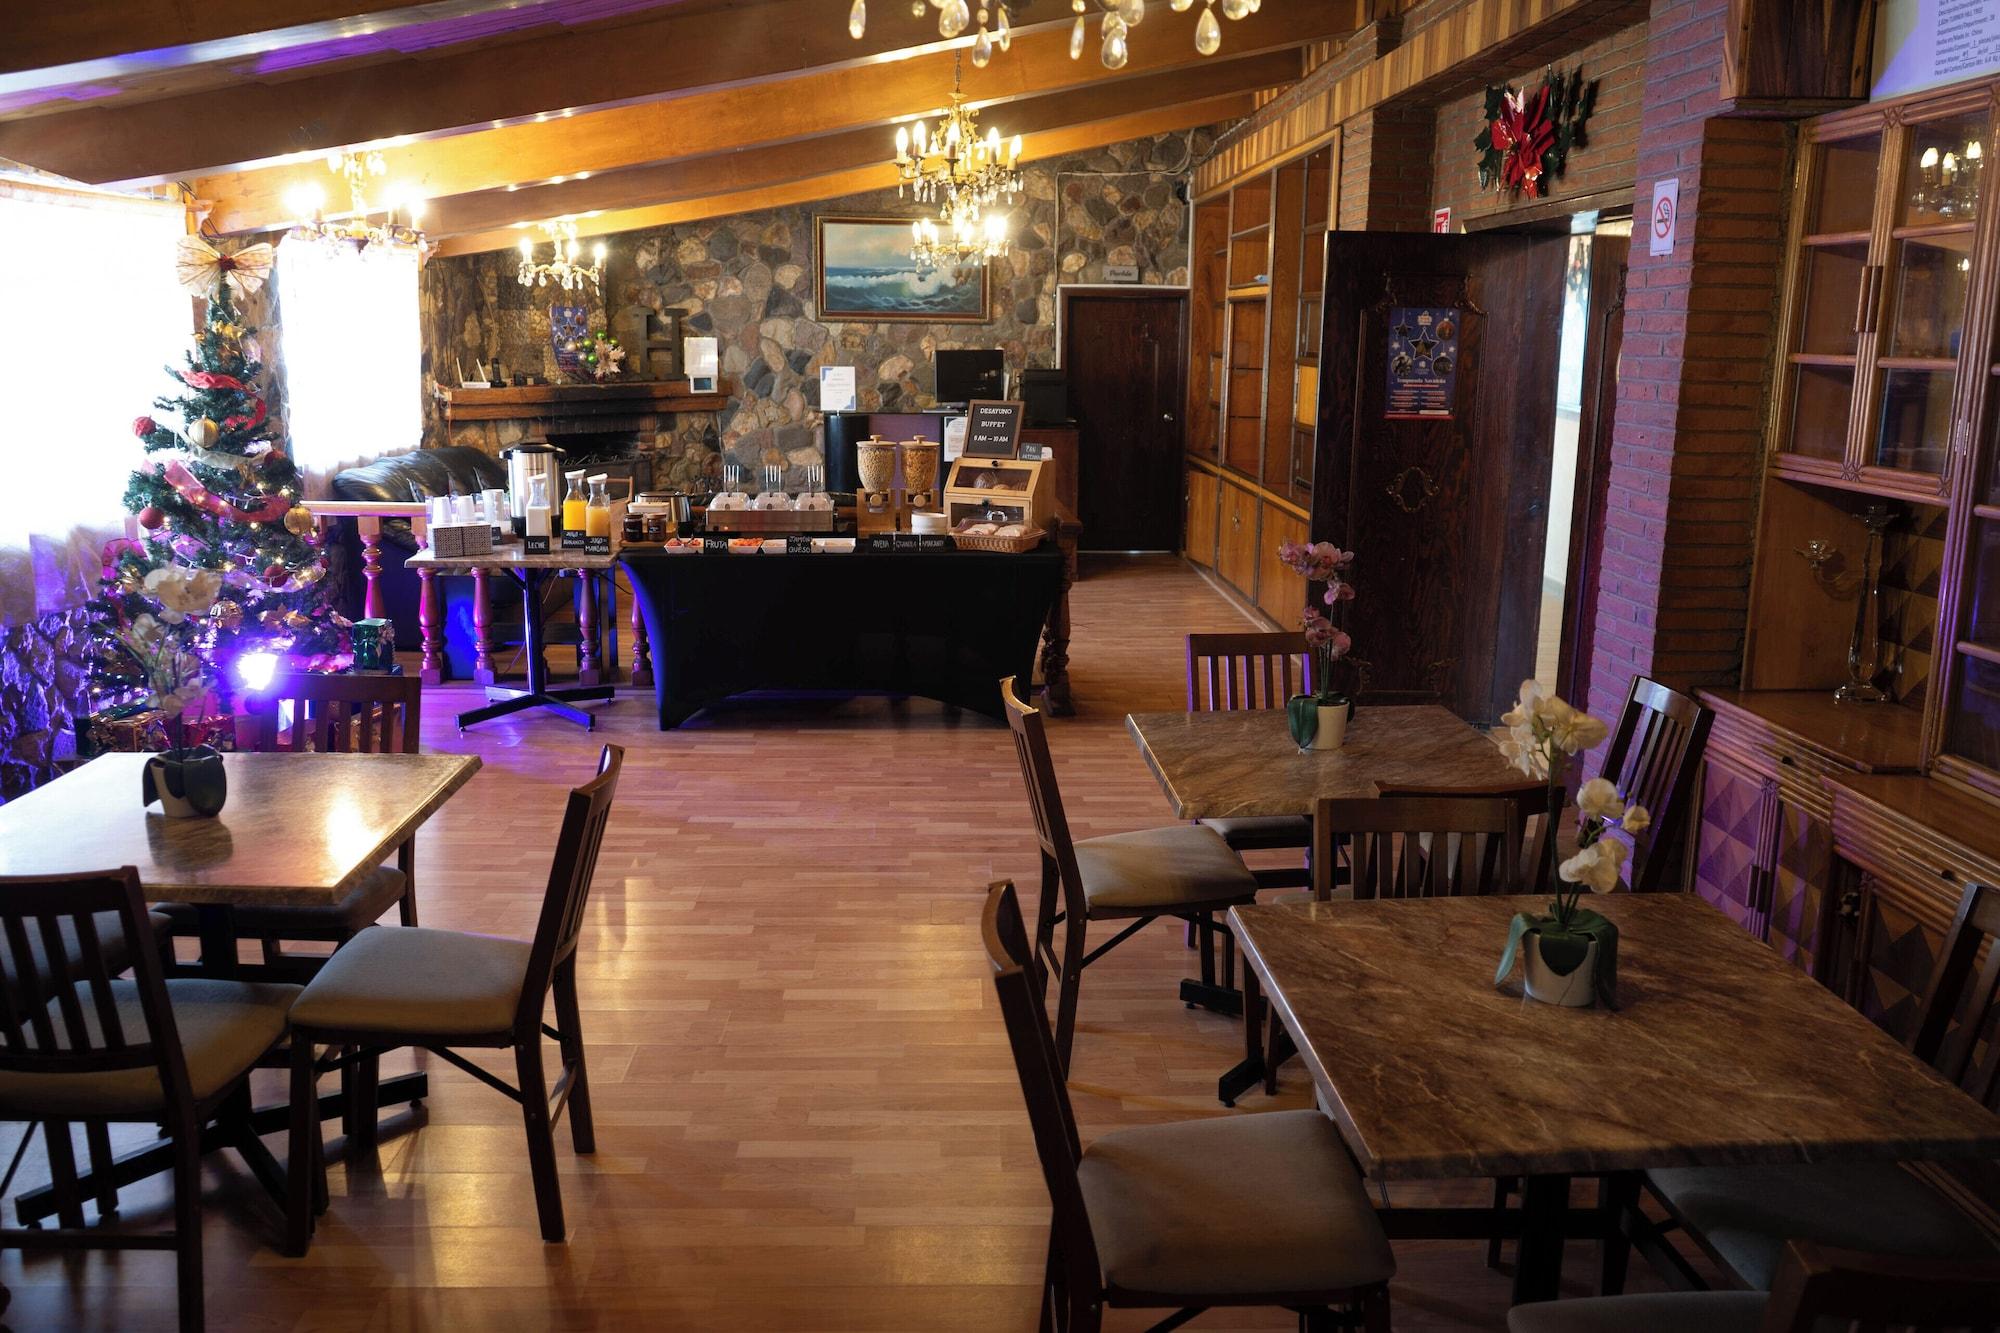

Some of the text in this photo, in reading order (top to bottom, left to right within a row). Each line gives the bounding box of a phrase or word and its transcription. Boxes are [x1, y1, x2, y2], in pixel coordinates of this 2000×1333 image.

[634, 305, 690, 379] H
[528, 541, 546, 549] LECHE
[705, 540, 728, 550] FRUTA
